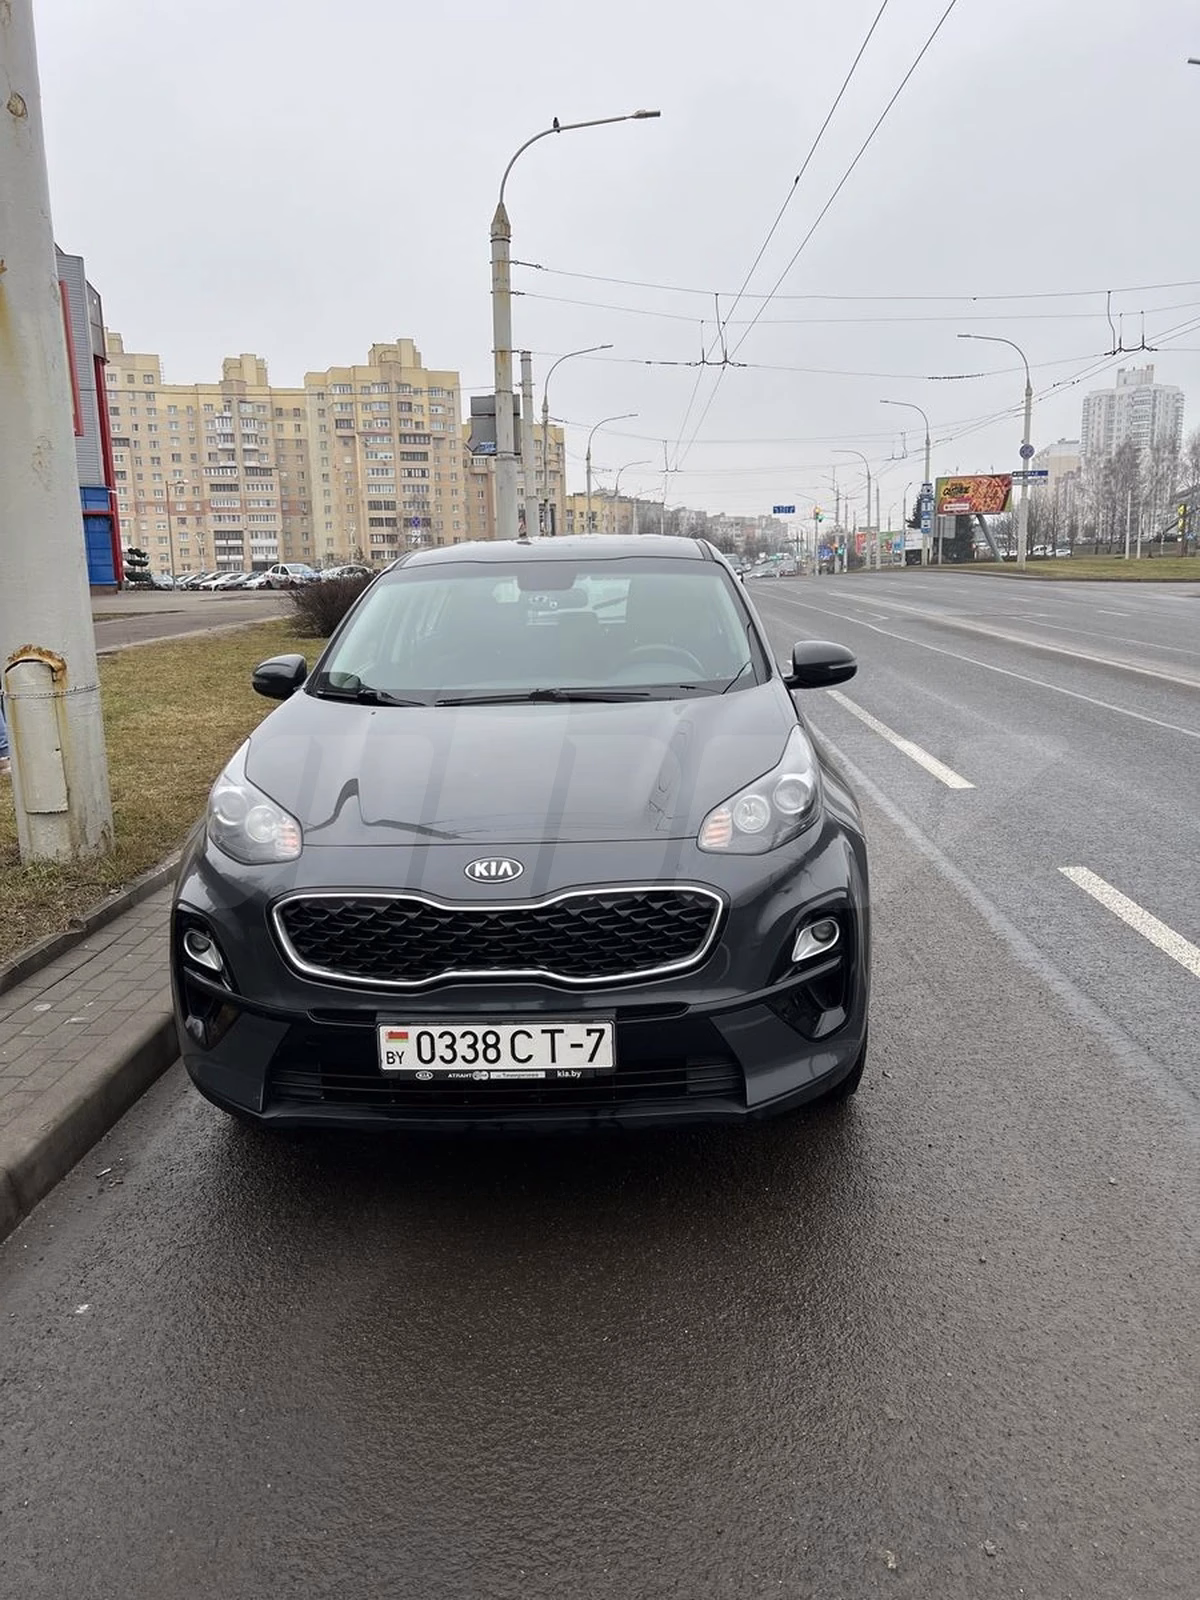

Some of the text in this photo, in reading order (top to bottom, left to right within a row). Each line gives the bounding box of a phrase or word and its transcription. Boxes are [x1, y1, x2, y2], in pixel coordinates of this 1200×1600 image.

[474, 861, 514, 877] KIA
[416, 1030, 501, 1065] 0338
[386, 1051, 405, 1065] BY
[556, 1070, 582, 1079] kia.by
